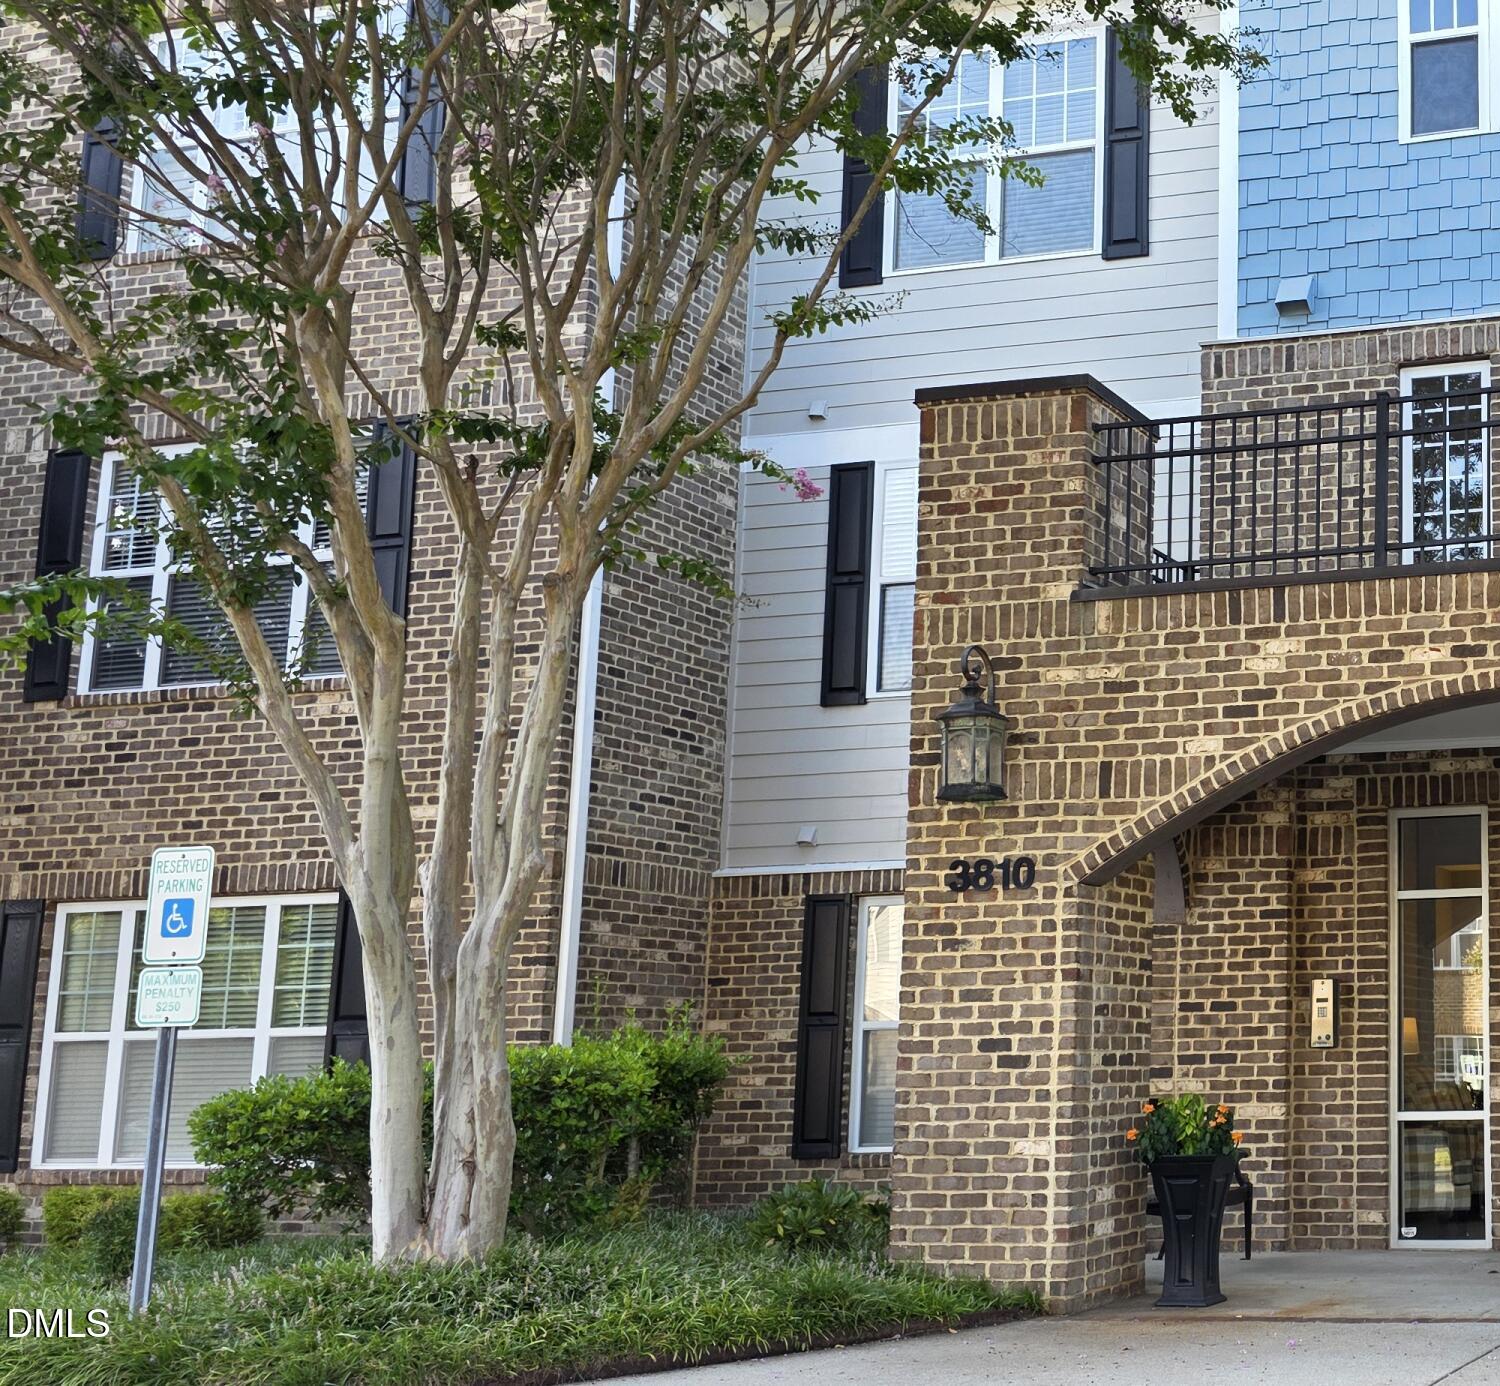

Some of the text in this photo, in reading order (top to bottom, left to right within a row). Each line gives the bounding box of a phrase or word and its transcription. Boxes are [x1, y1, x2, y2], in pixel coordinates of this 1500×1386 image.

[156, 859, 208, 874] RESERVED
[949, 856, 1035, 892] 3810
[157, 878, 203, 893] PARKING
[145, 974, 197, 986] MAXIMUM
[145, 988, 194, 999] PENALTY
[156, 1001, 181, 1012] $250
